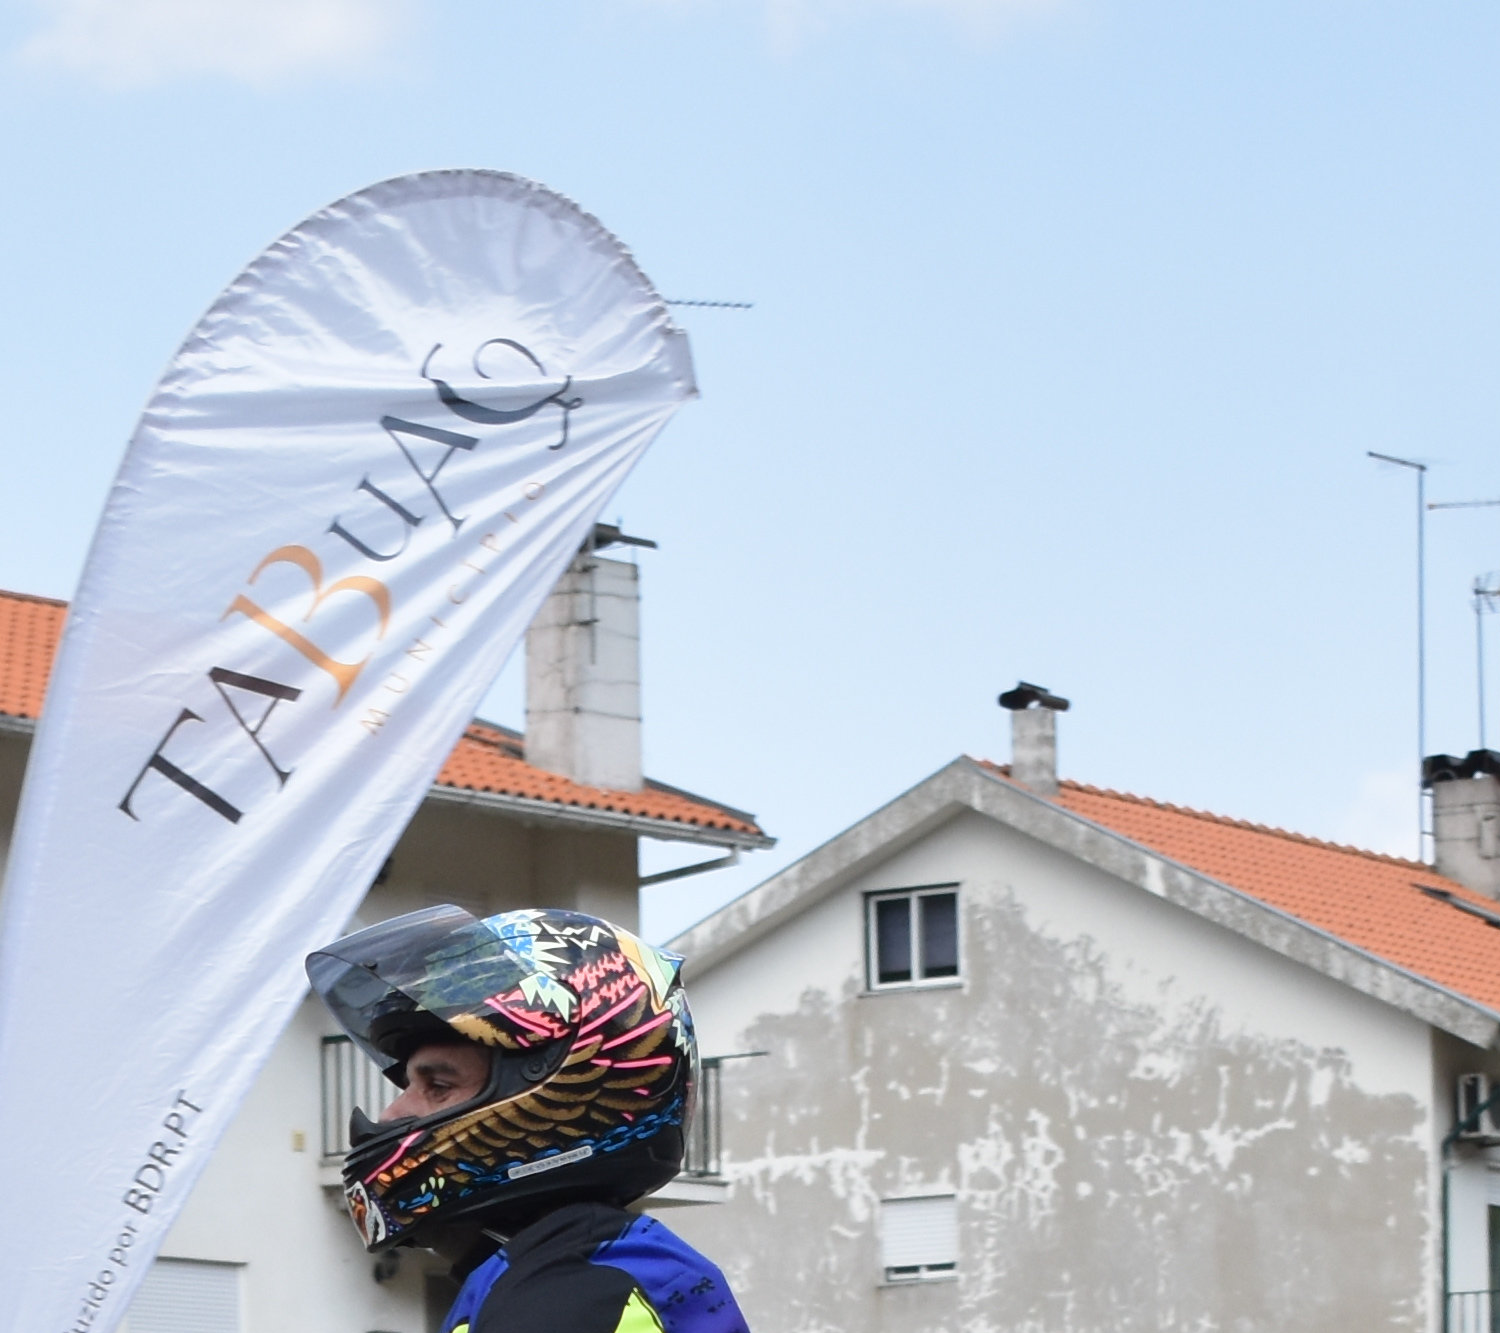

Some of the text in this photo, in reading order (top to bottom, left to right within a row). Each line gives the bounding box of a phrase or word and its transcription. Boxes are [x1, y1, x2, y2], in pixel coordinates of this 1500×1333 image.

[118, 337, 584, 826] TABUAÇO
[123, 1088, 205, 1215] BDR.PT
[108, 1223, 144, 1269] por
